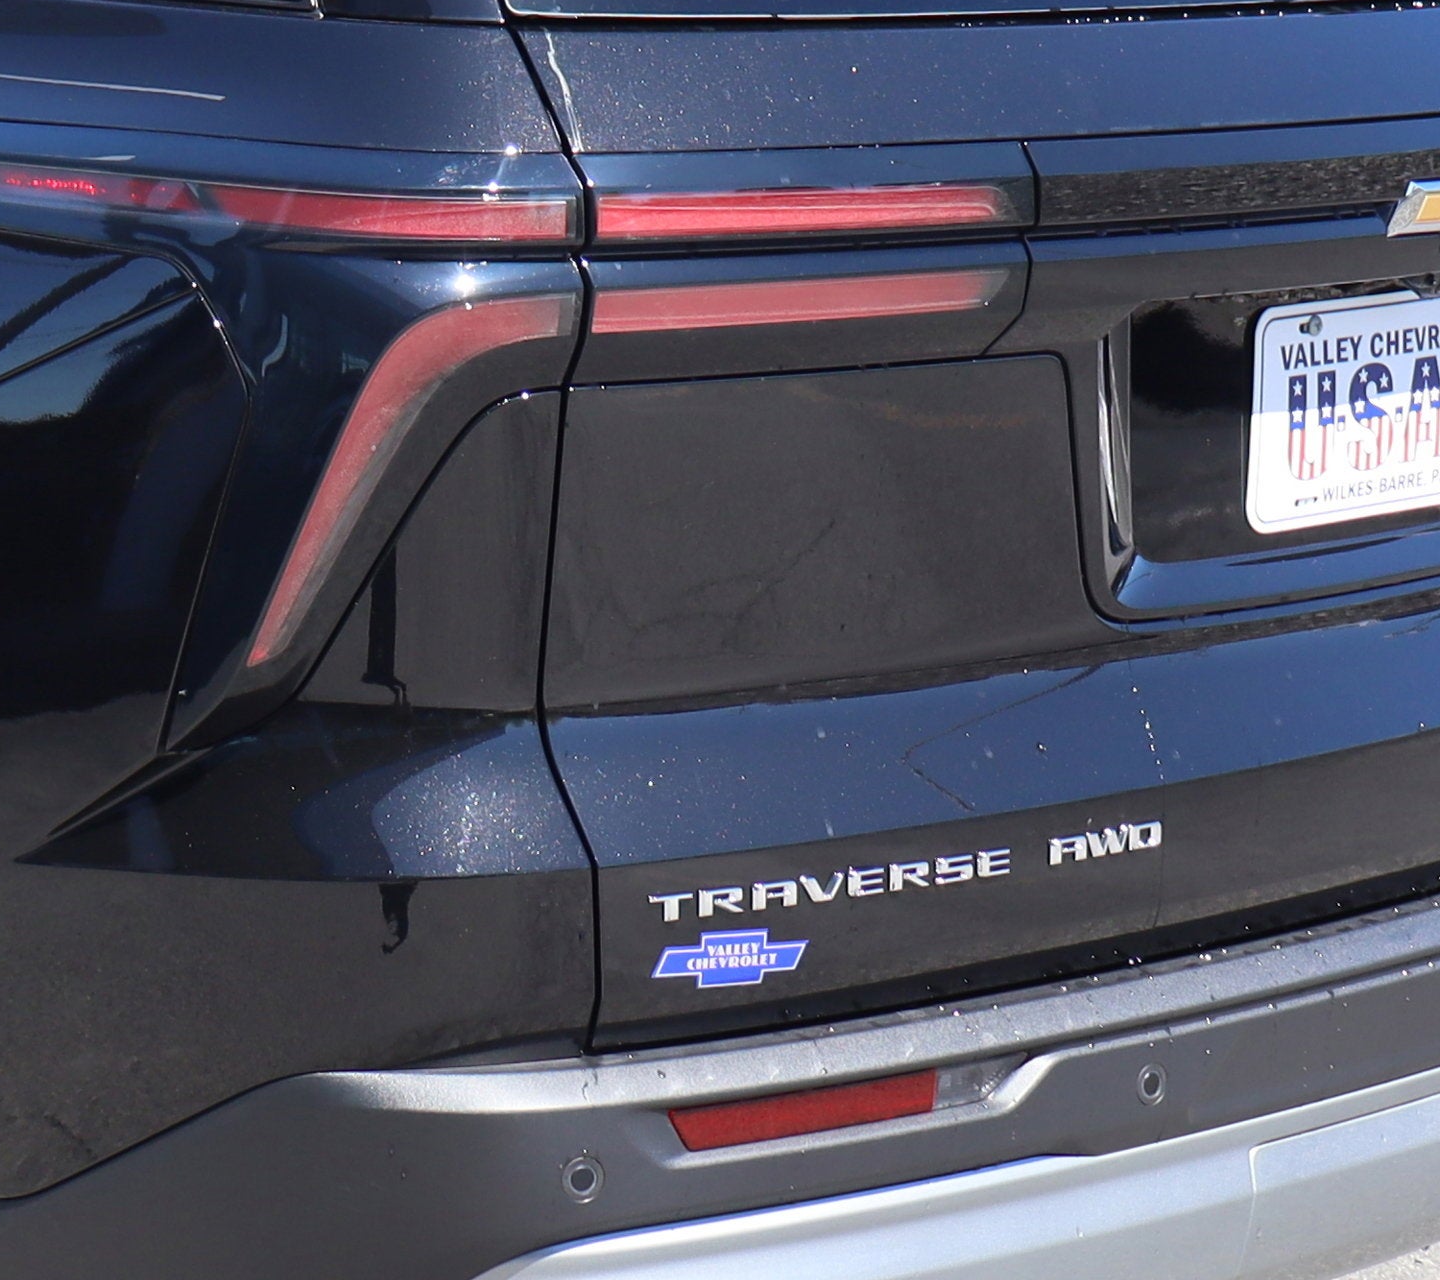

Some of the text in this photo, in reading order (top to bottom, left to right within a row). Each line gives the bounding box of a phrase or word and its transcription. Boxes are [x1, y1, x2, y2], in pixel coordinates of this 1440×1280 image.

[1280, 334, 1363, 371] VALLEY
[647, 820, 1162, 922] TRAVERSE AWD
[686, 952, 778, 971] CHEVROLET
[706, 942, 762, 957] VALLEY
